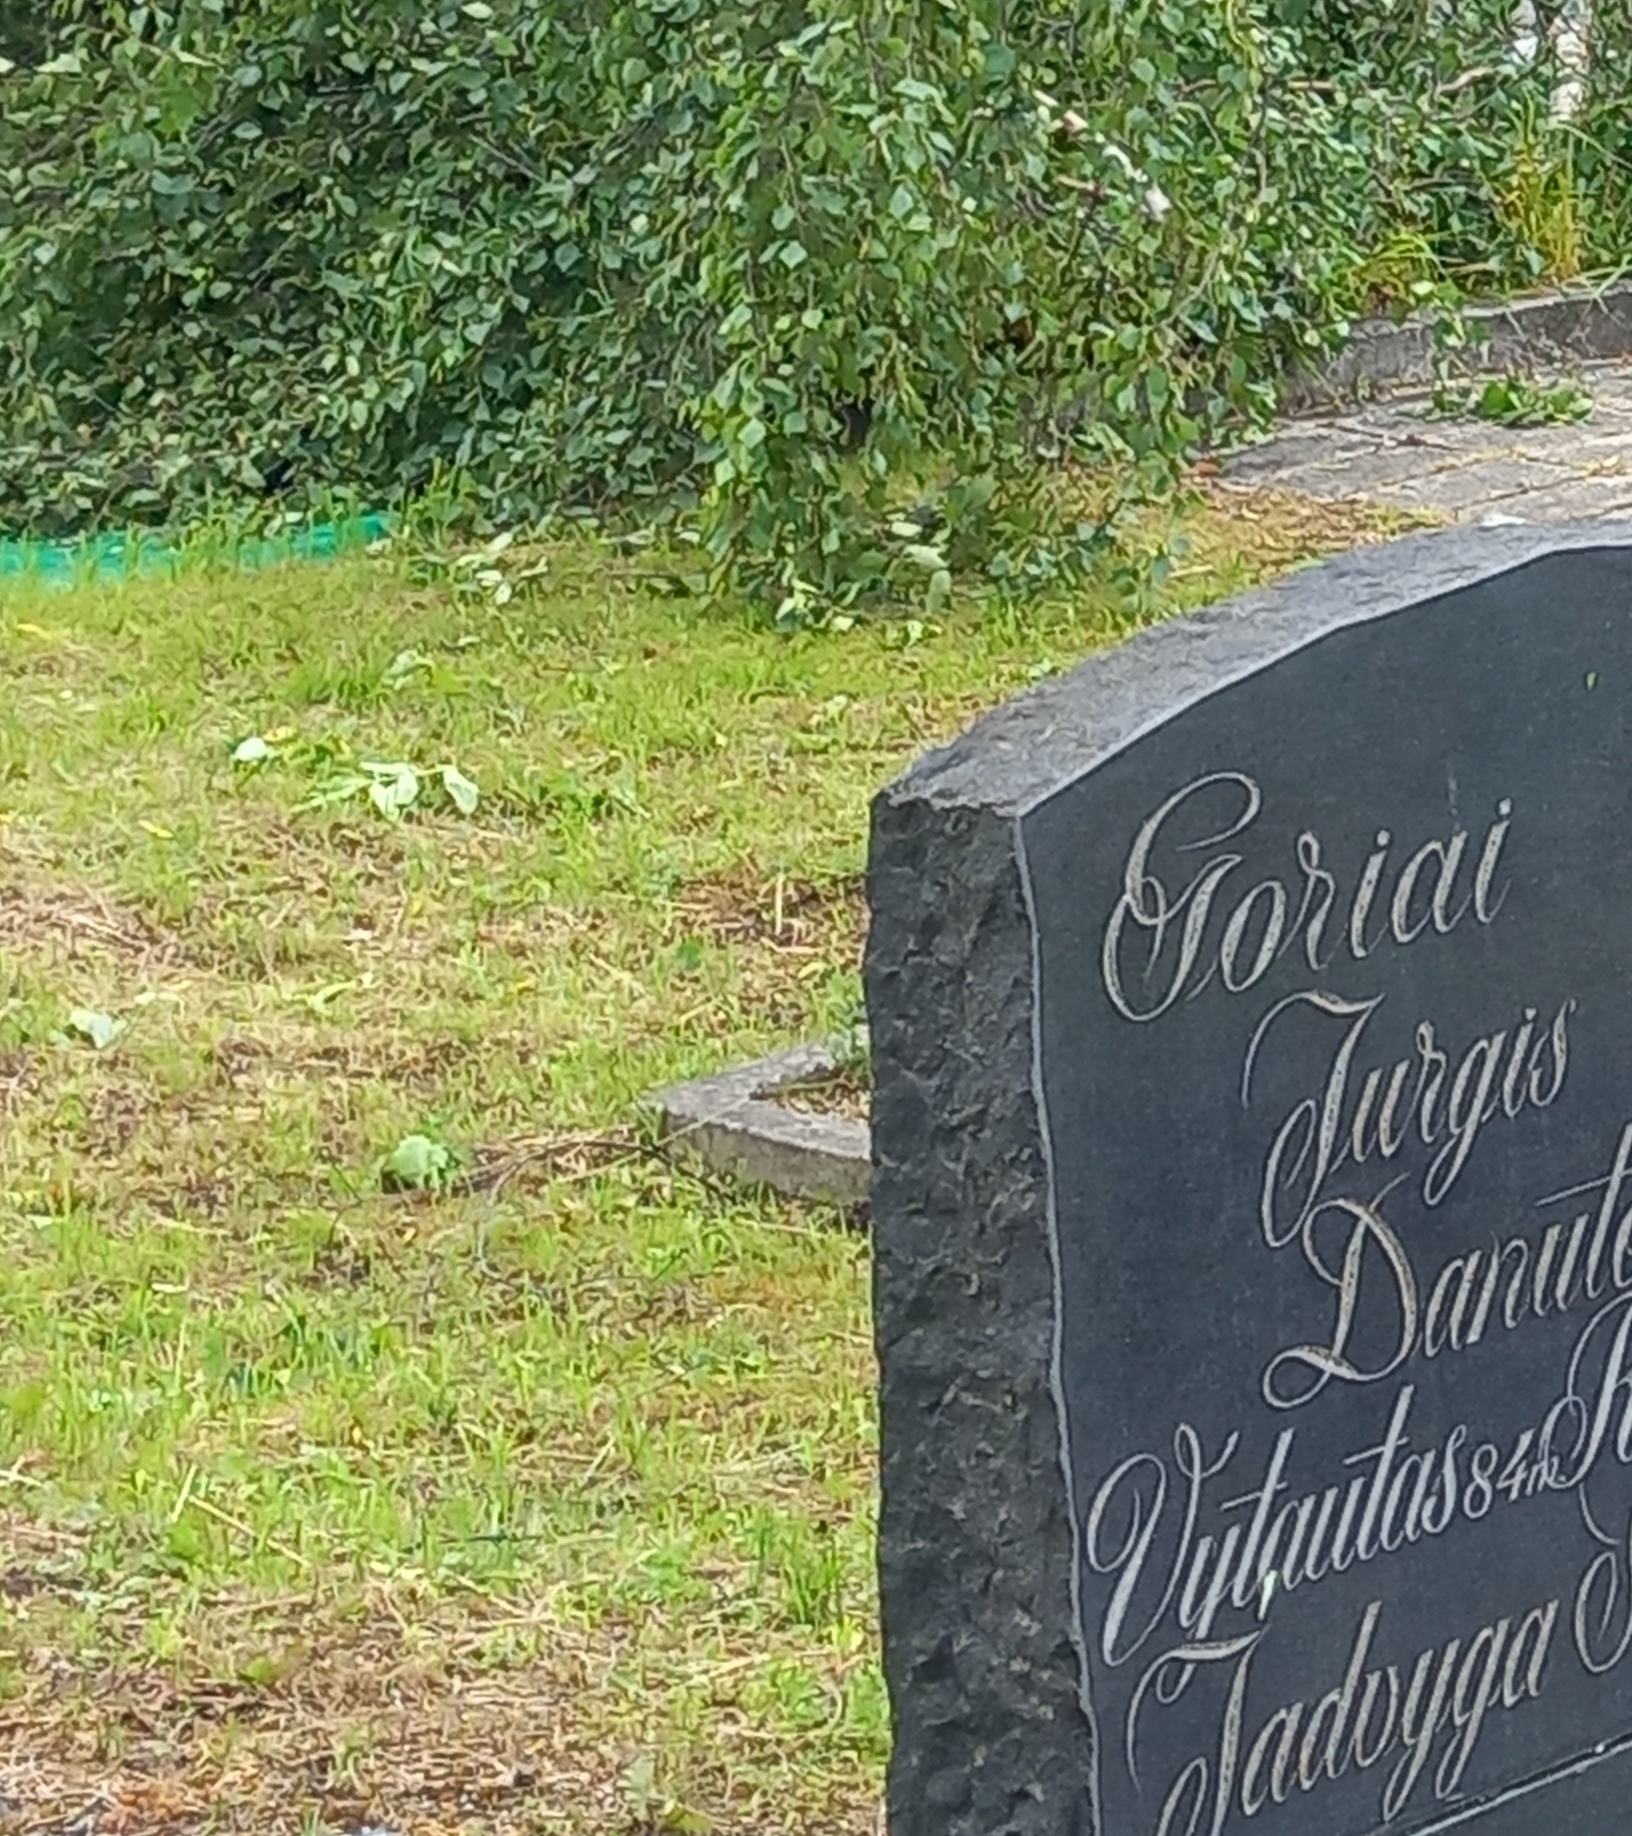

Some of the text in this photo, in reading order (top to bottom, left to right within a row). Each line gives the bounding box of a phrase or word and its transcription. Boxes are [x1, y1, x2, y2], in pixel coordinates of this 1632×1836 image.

[1102, 771, 1512, 1021] Goriai
[1242, 990, 1577, 1247] Jurgis
[1088, 1384, 1466, 1703] Vytautas
[1125, 1600, 1558, 1836] Jadvyga
